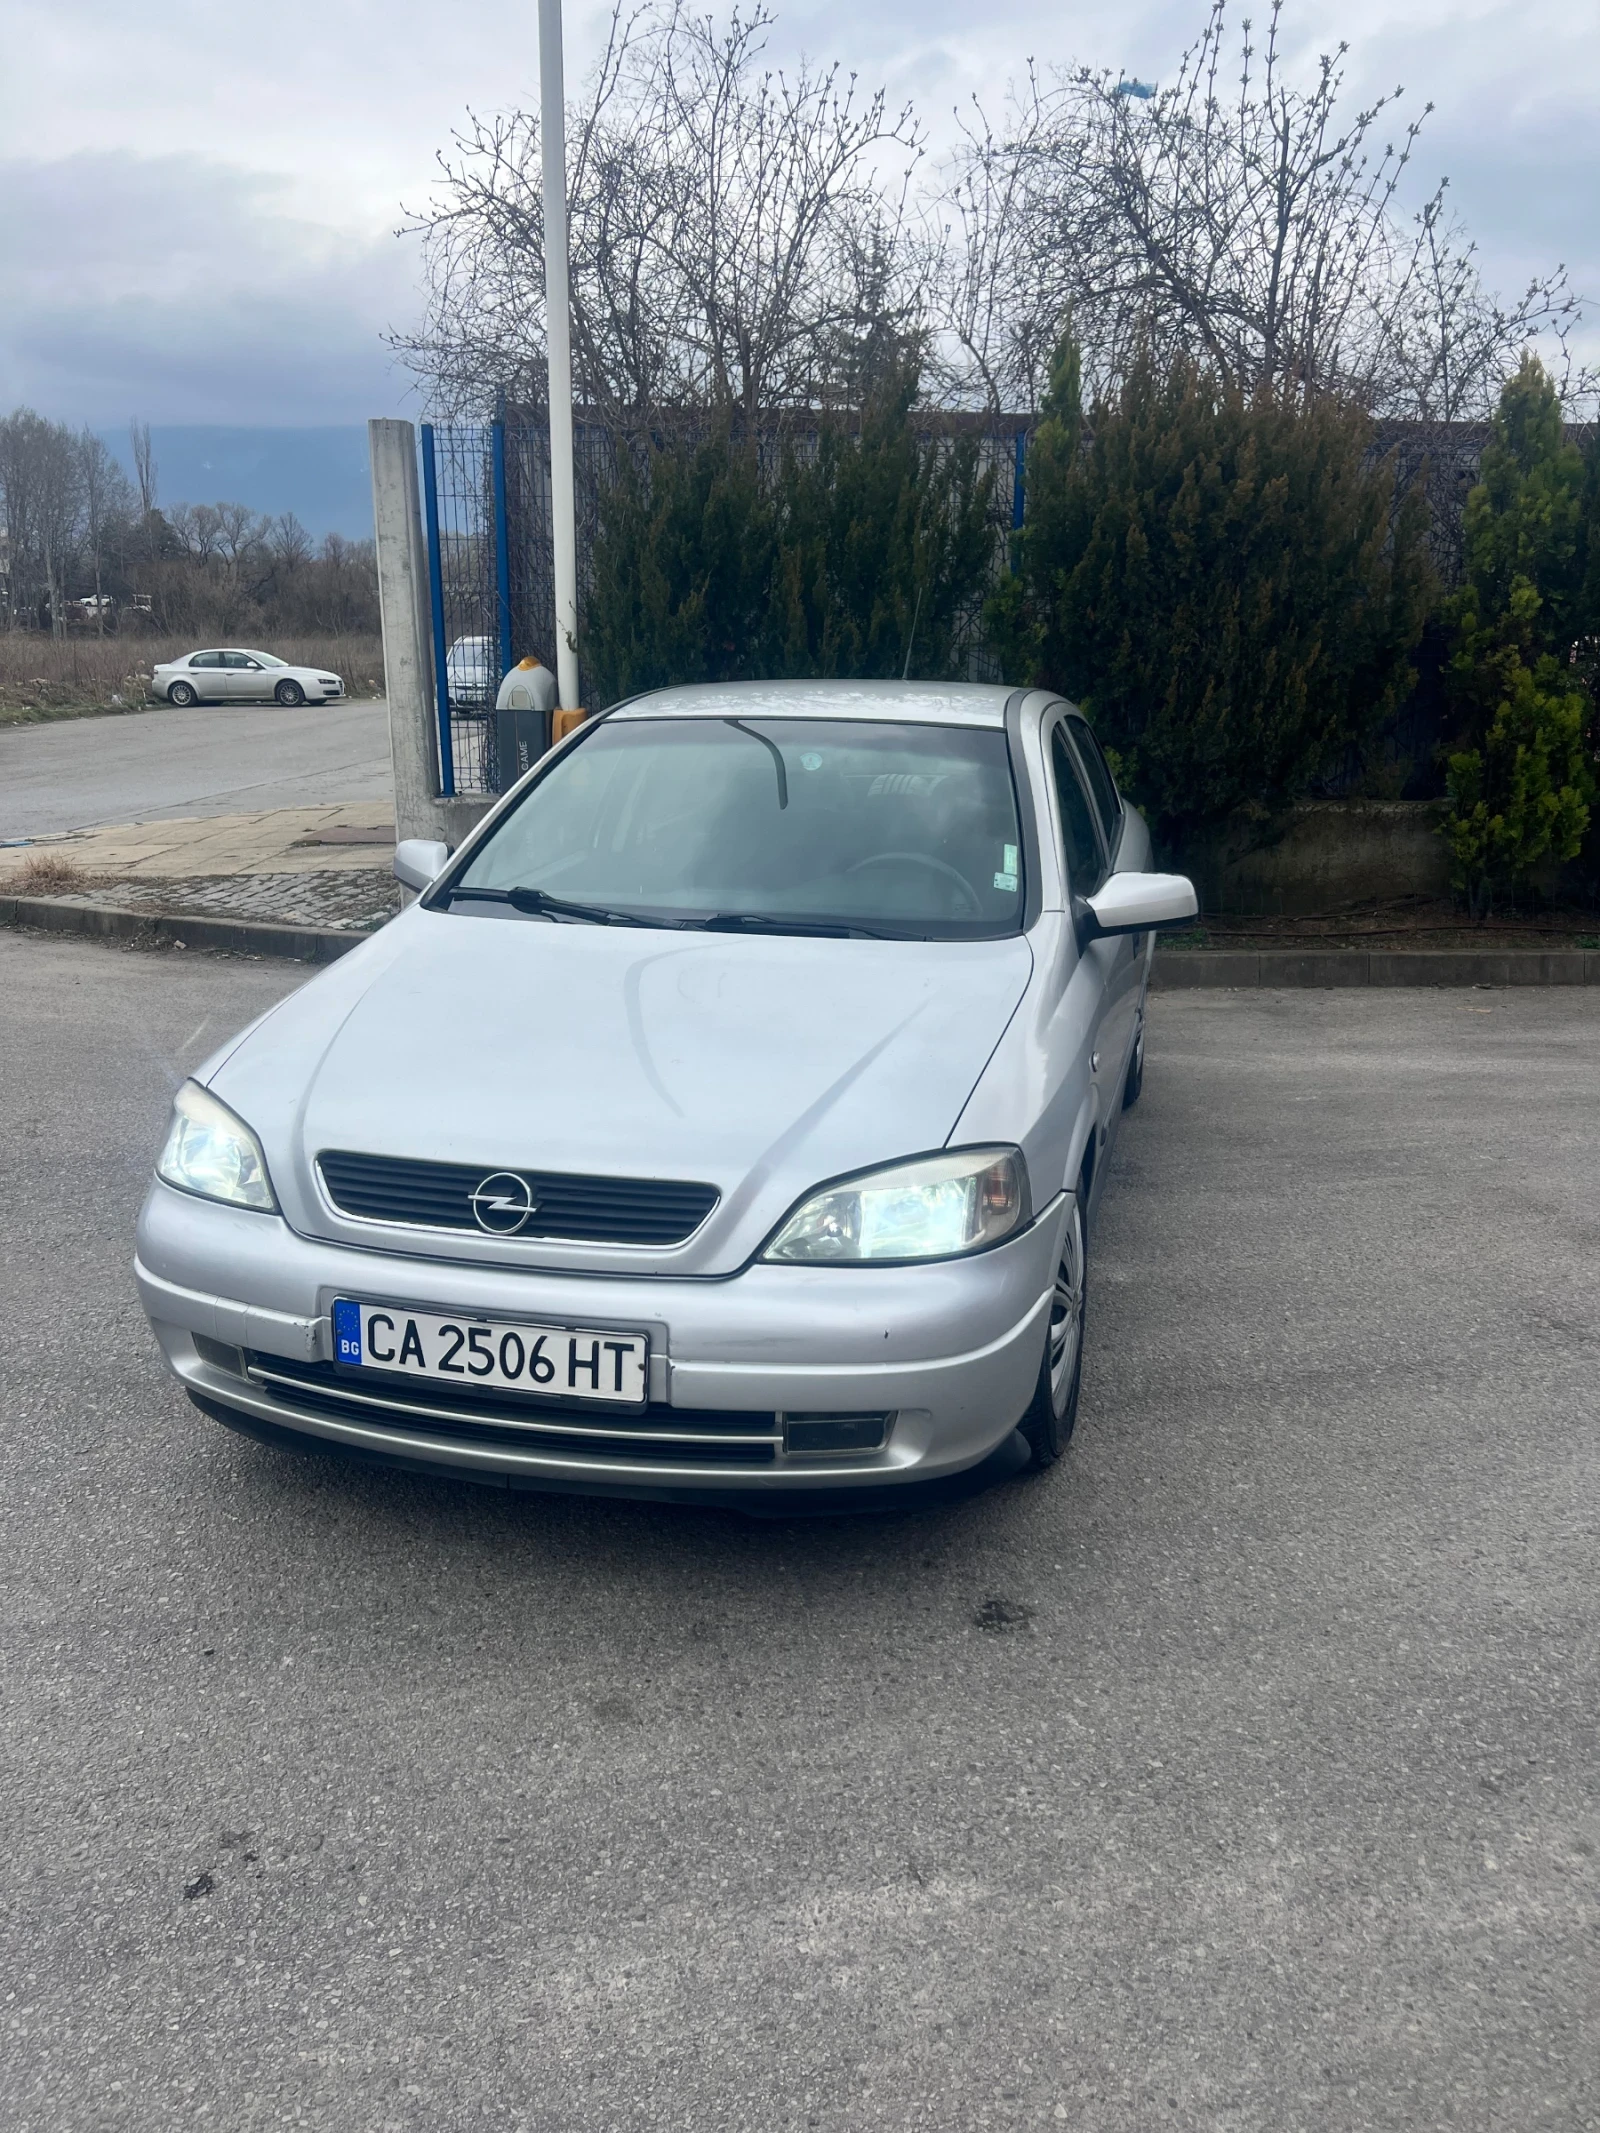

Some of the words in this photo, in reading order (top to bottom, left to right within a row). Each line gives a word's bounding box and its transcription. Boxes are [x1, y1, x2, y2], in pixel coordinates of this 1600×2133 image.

[519, 741, 529, 771] CAME
[341, 1339, 360, 1356] BG
[367, 1313, 426, 1368] CA
[438, 1324, 555, 1383] 2506
[568, 1338, 635, 1391] HT
